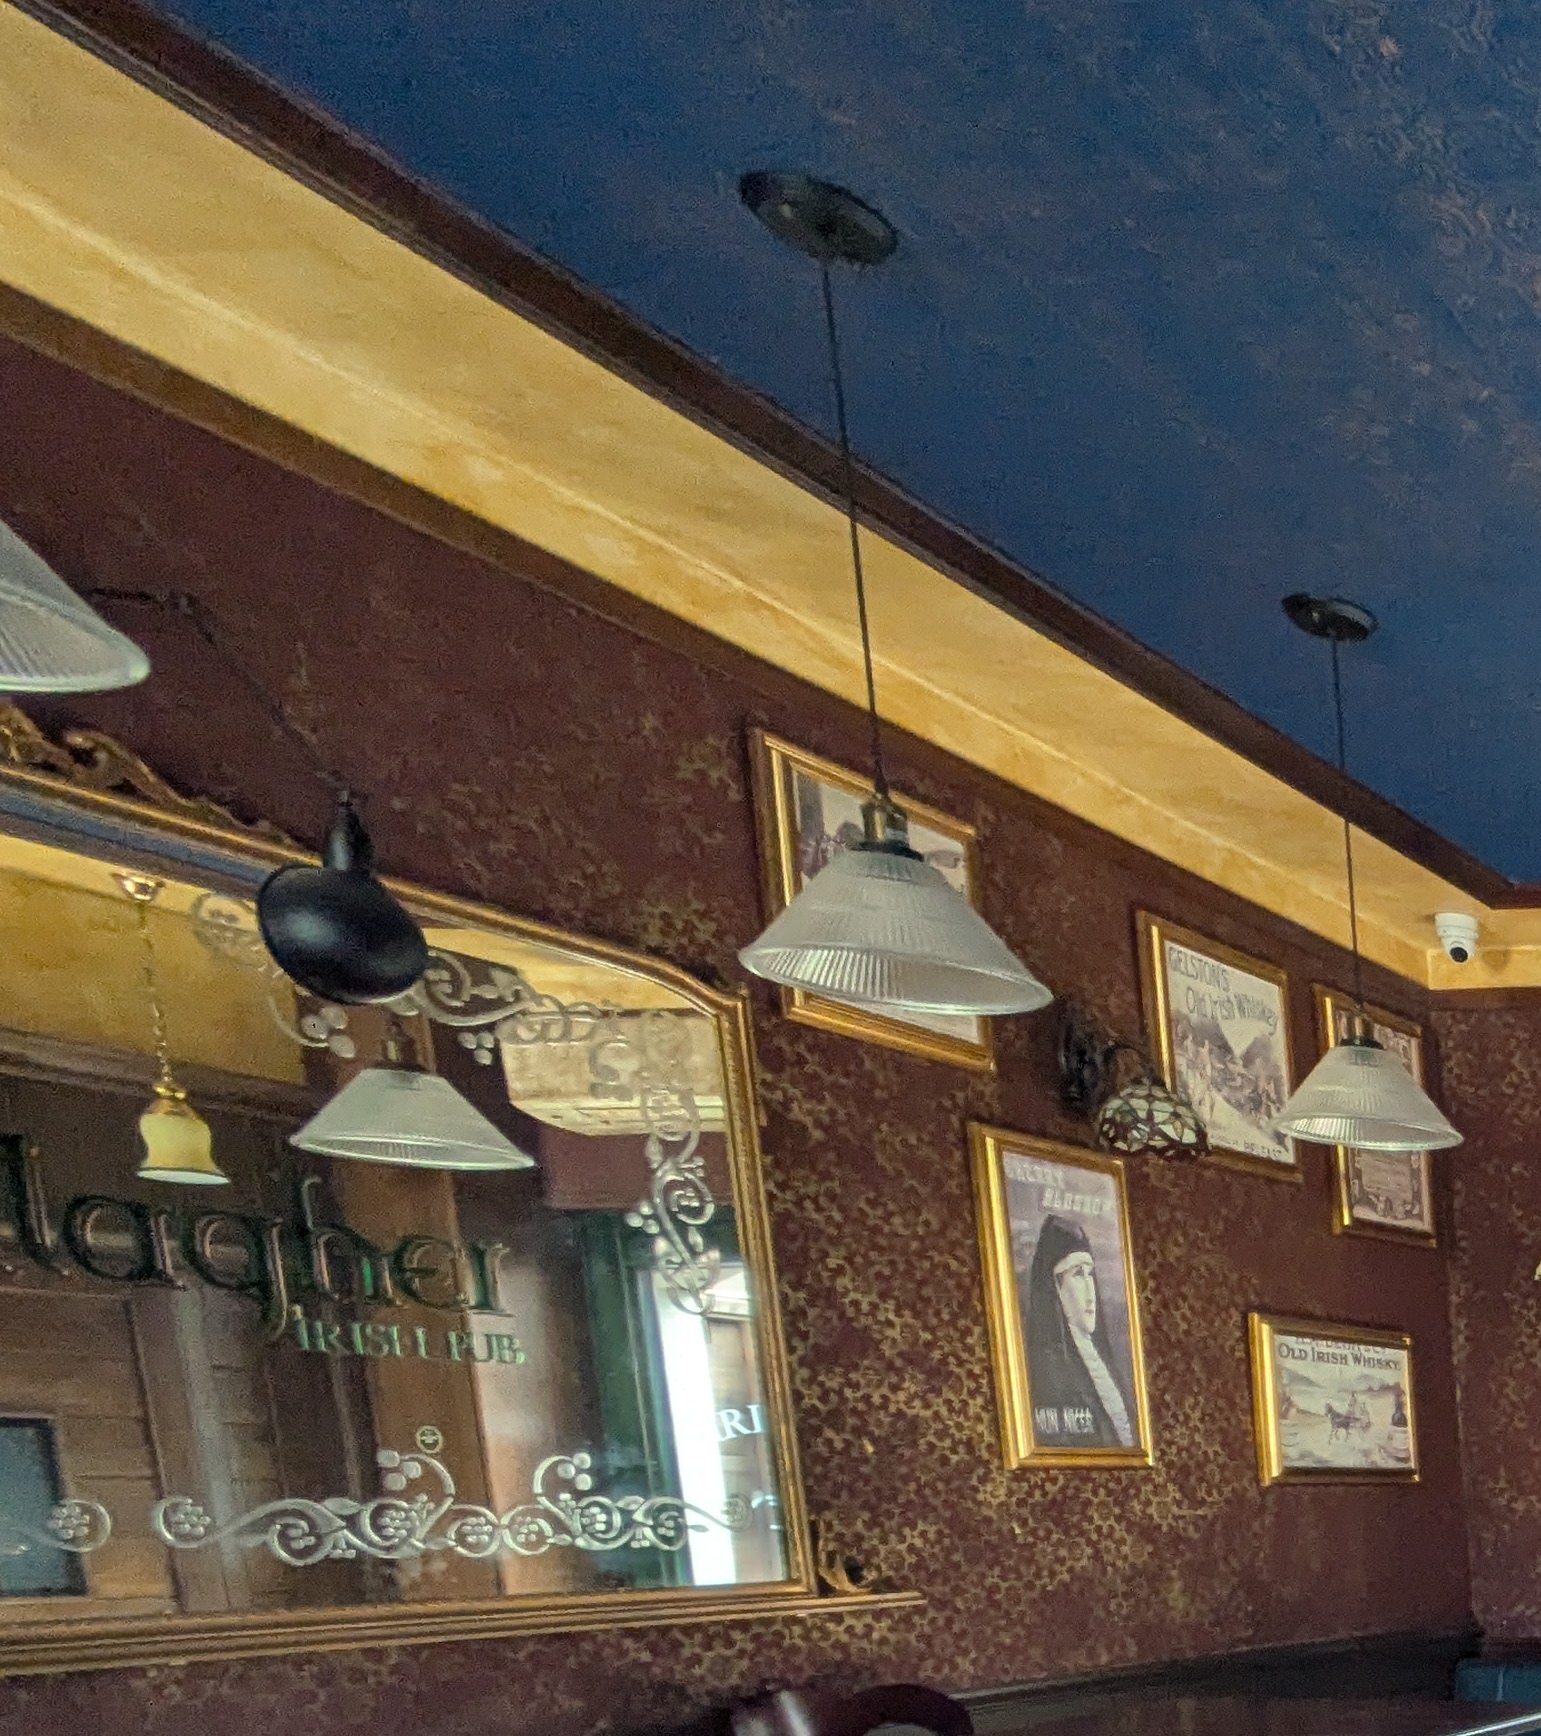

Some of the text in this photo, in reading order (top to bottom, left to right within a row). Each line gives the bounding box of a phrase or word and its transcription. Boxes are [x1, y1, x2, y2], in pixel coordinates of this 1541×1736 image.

[447, 1328, 526, 1364] PUB
[1278, 1342, 1308, 1360] OLD
[1311, 1346, 1348, 1366] IRISH
